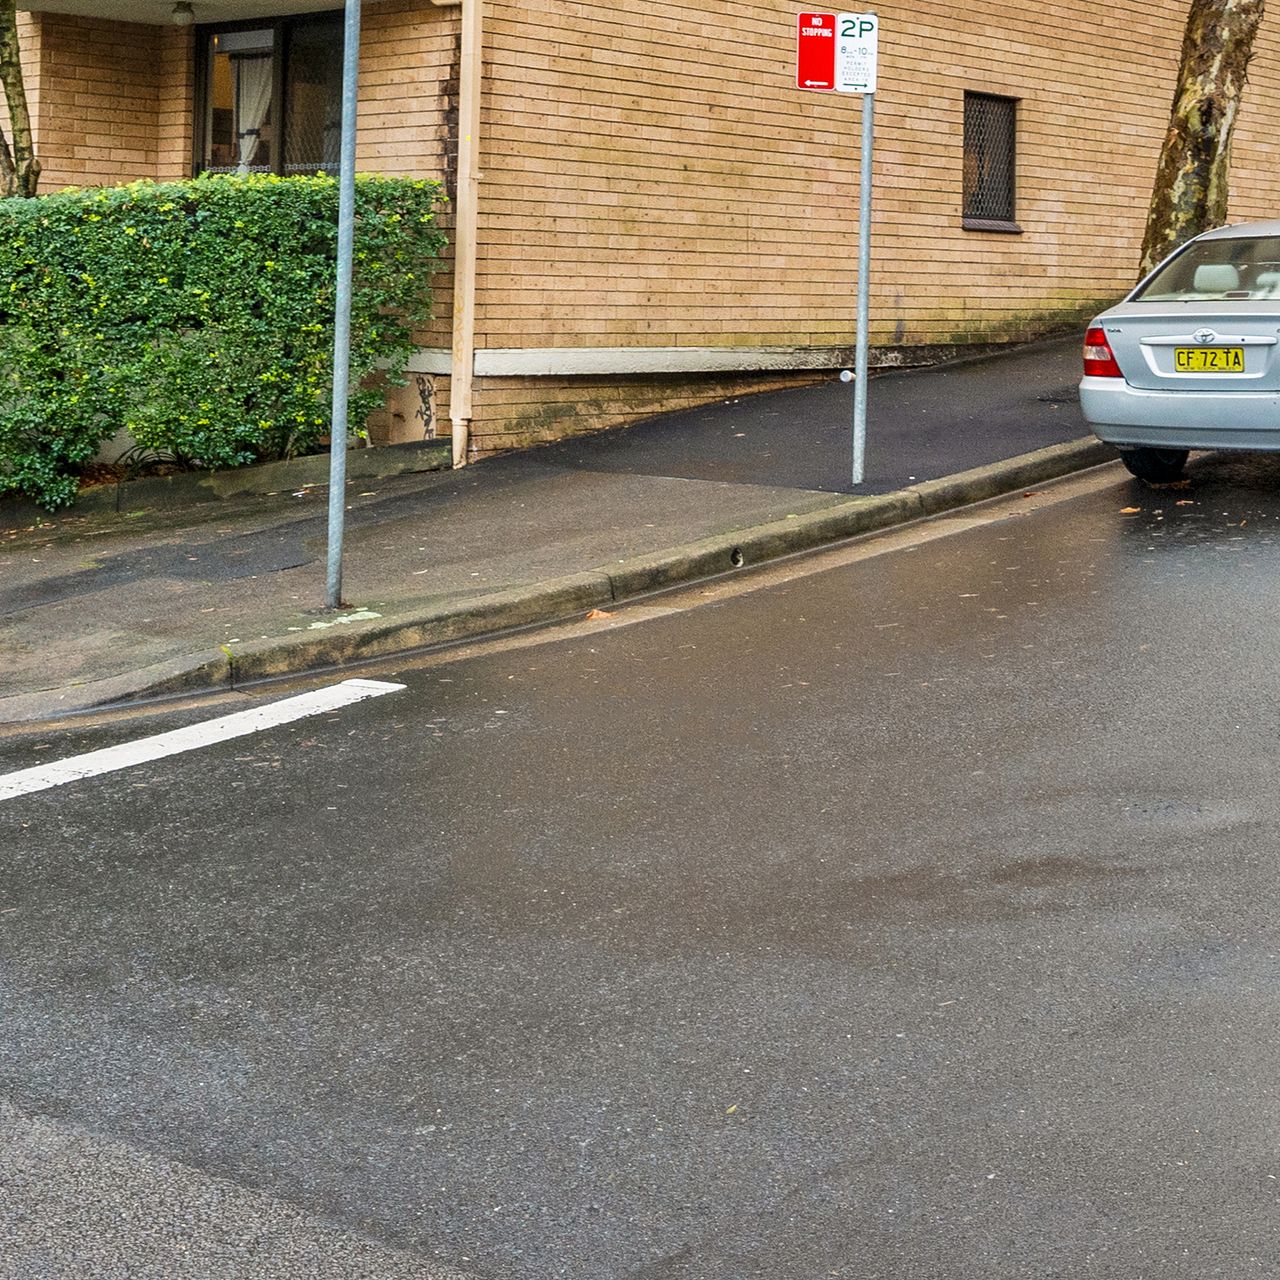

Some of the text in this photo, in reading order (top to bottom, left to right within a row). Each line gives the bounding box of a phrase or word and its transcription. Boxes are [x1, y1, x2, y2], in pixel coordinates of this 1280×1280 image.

[811, 17, 823, 26] NO
[802, 27, 833, 37] STOPPING
[841, 19, 874, 38] 2P
